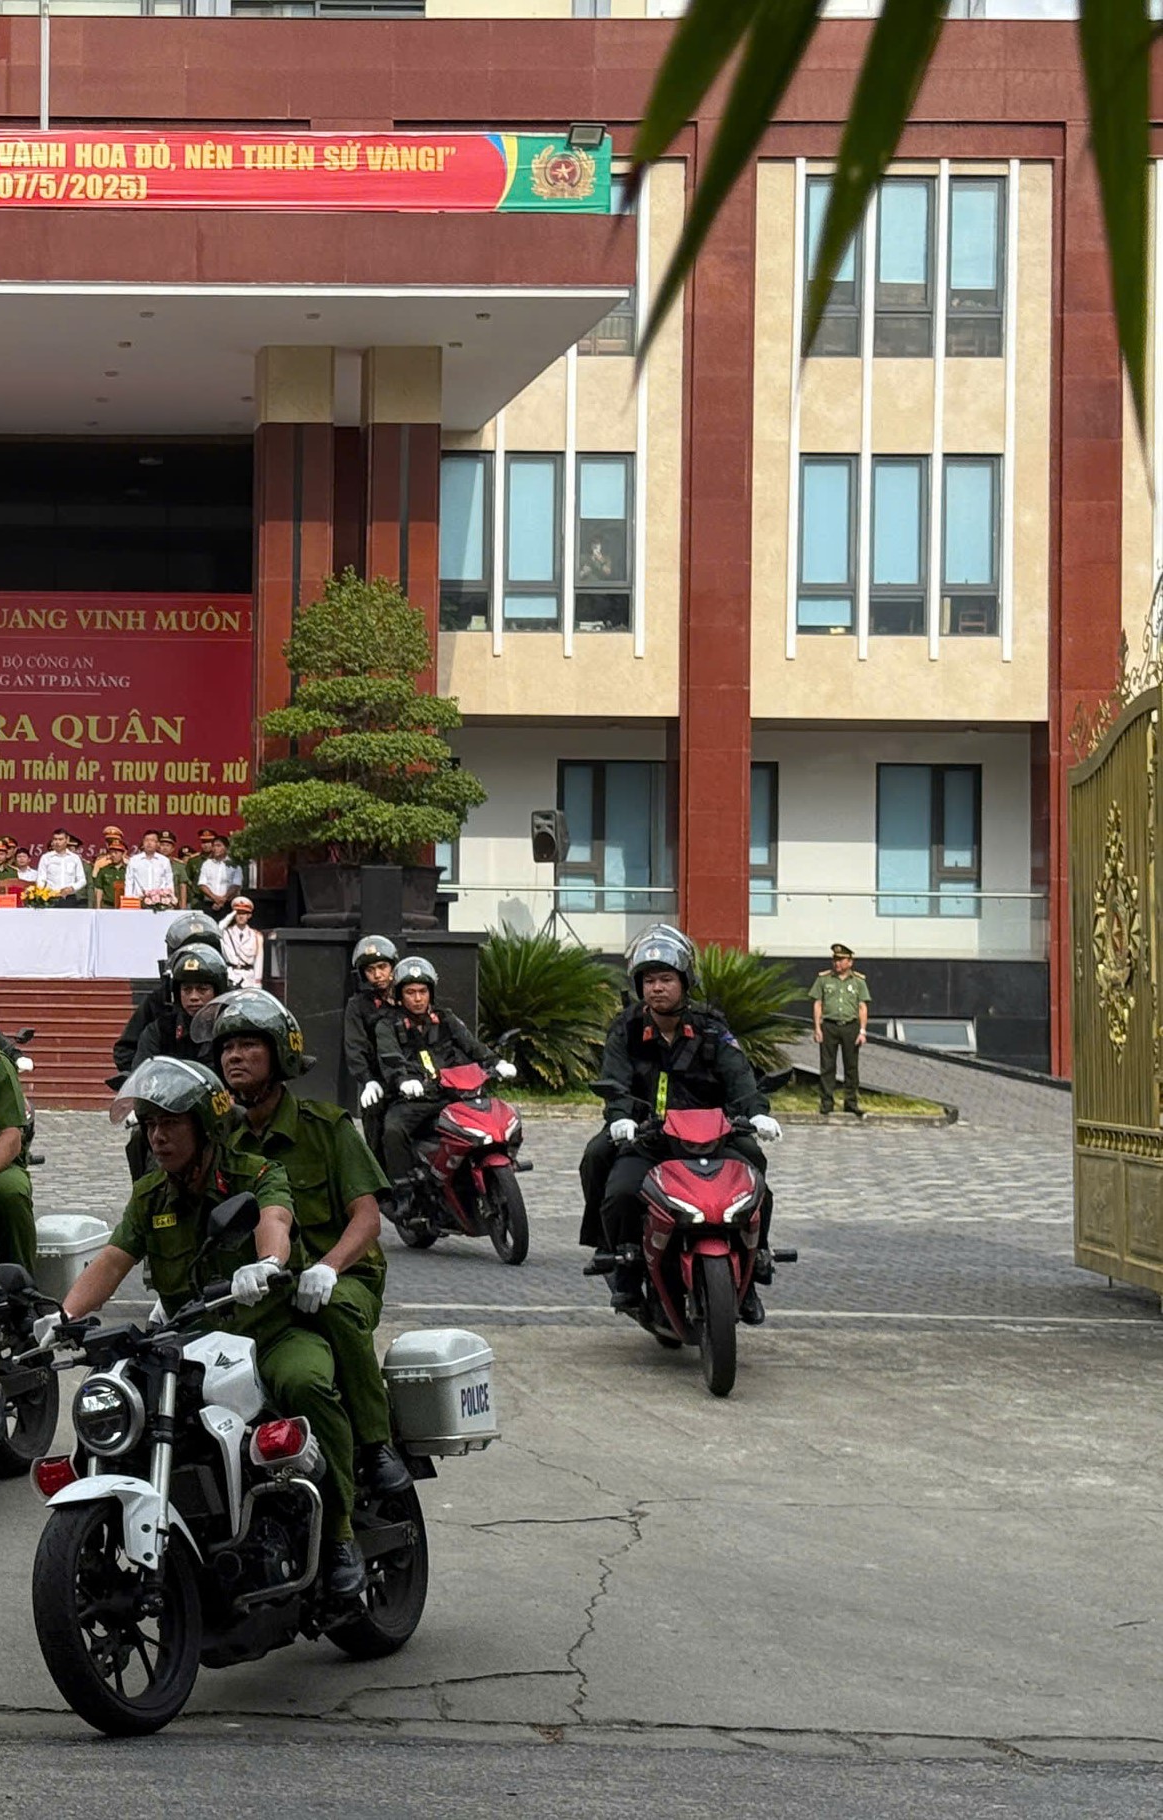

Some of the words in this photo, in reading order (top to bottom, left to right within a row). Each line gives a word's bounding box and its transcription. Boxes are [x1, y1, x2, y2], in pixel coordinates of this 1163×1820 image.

[74, 143, 127, 168] HOA
[134, 138, 177, 172] ĐỎ,
[184, 140, 233, 170] NÊN
[241, 141, 315, 171] THIÊN
[323, 139, 361, 171] SỬ
[75, 609, 147, 631] VINH
[154, 605, 241, 632] MUÔN
[2, 655, 23, 670] BỘ
[26, 653, 69, 669] CÔNG
[72, 656, 94, 669] AN
[12, 675, 34, 687] AN
[37, 675, 58, 688] TP
[60, 672, 83, 688] ĐÀ
[51, 708, 185, 749] QUÂN
[22, 752, 69, 781] TRẤN
[112, 761, 158, 782] TRUY
[222, 756, 249, 783] XỬ
[8, 788, 57, 814] PHÁP
[63, 788, 108, 819] LUẬT
[114, 790, 160, 815] TRÊN
[166, 790, 231, 816] ĐƯỜNG
[460, 1382, 490, 1418] POLICE
